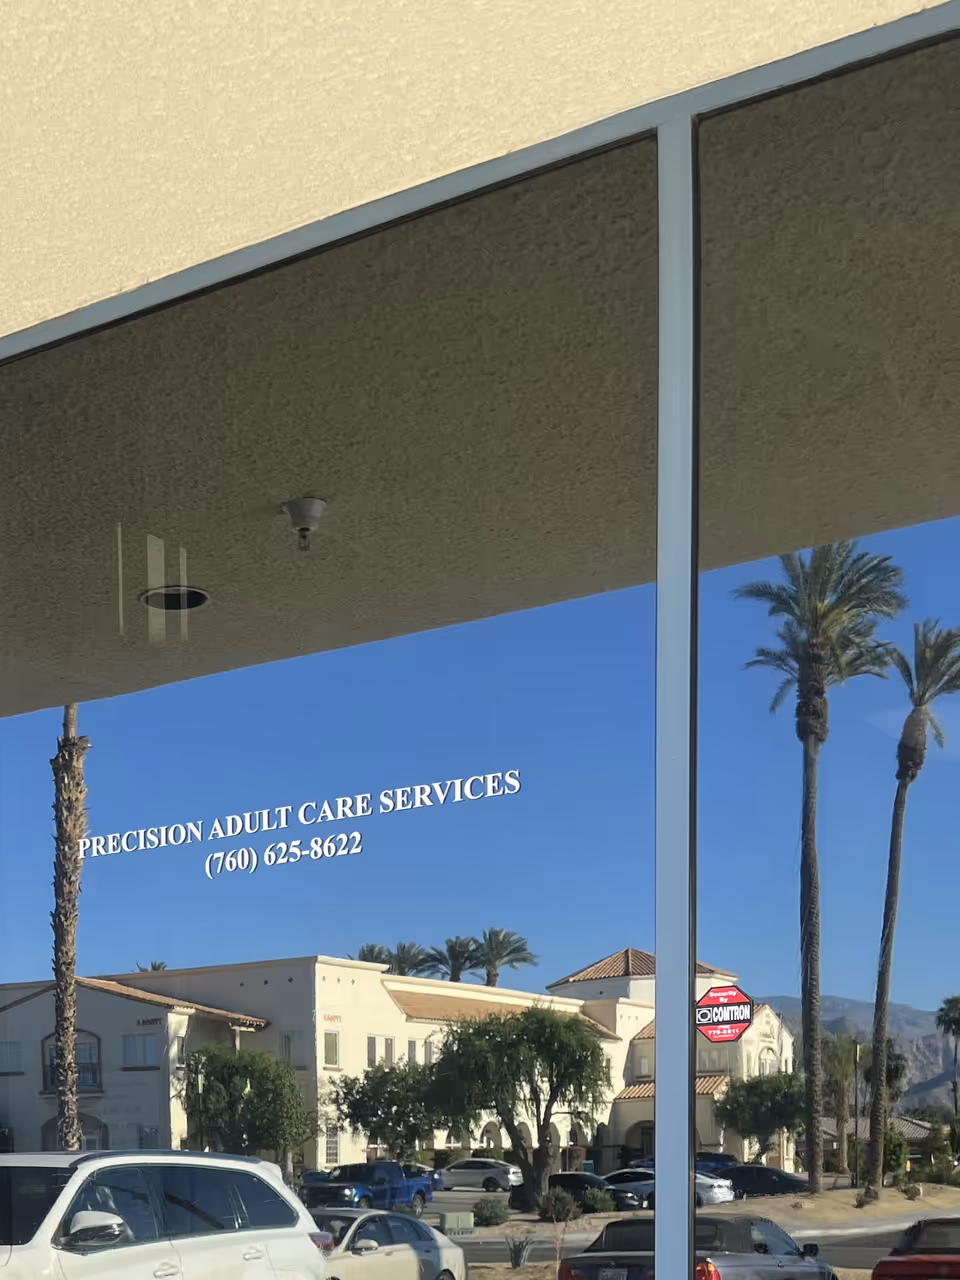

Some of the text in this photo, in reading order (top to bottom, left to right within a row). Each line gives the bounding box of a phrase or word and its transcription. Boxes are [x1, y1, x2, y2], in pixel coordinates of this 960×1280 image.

[78, 770, 521, 859] PRECISION ADULT CARE SERVICES
[205, 831, 362, 879] (760) 625-8622
[713, 1005, 750, 1022] COMTRON
